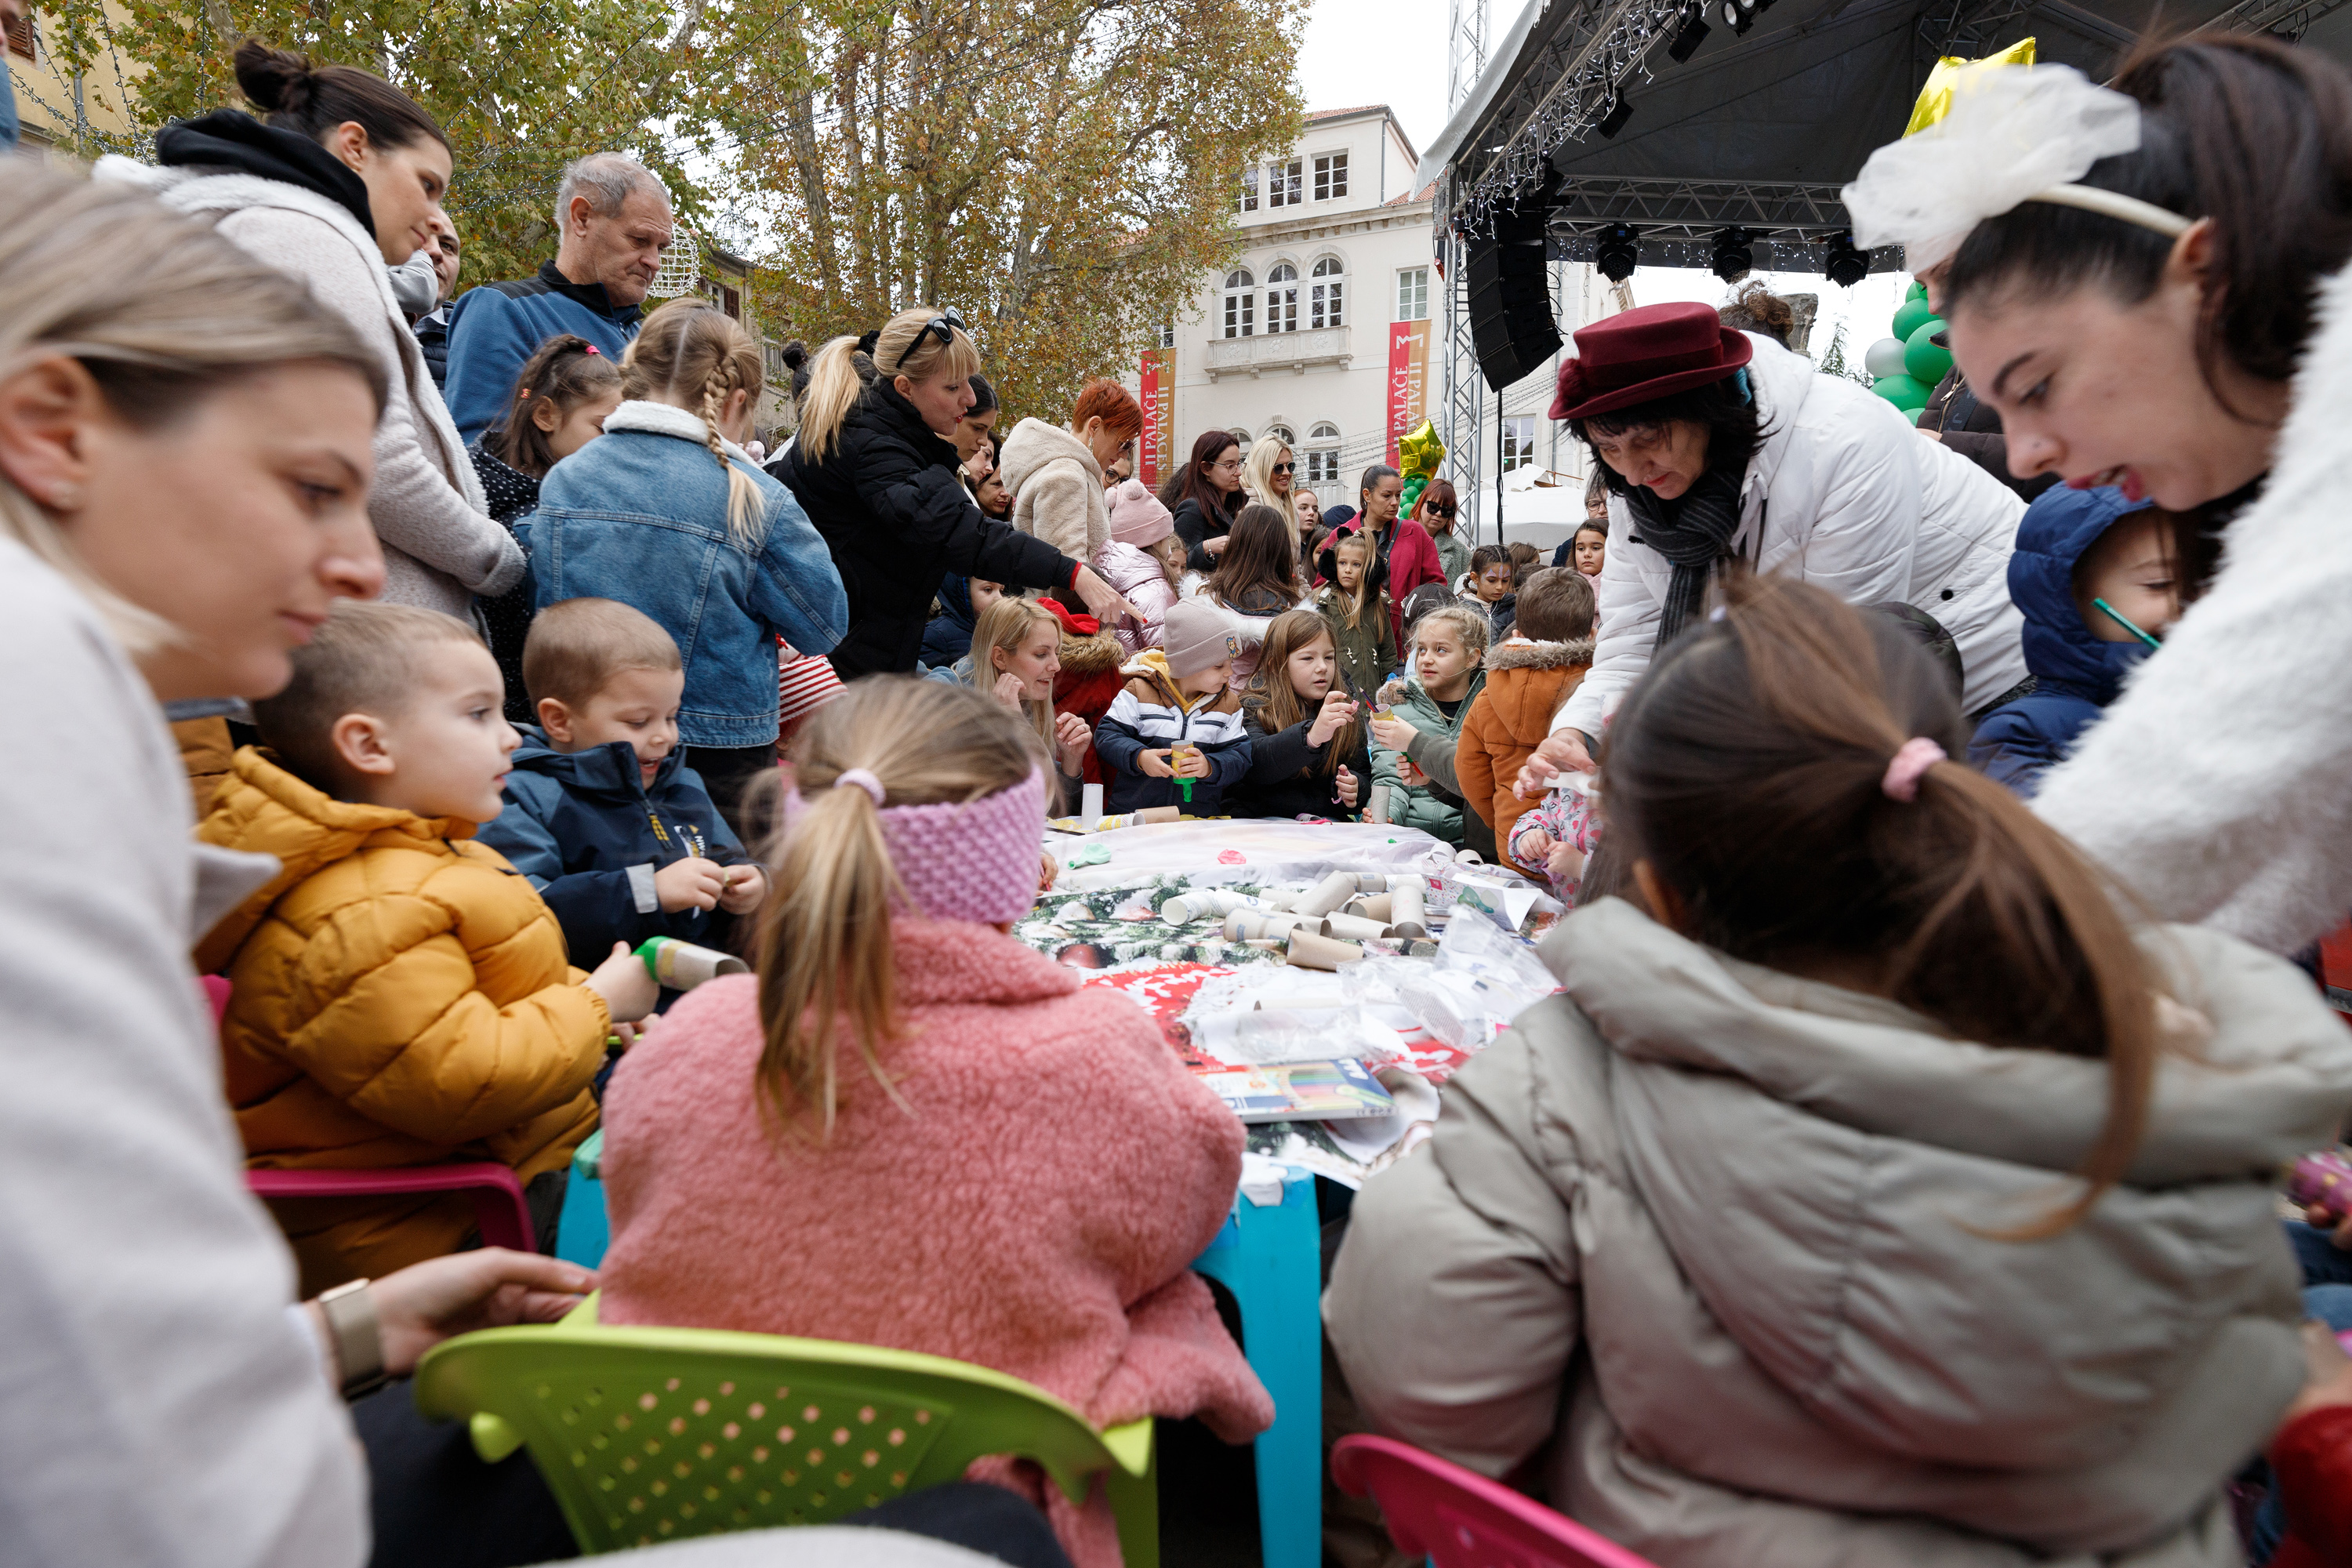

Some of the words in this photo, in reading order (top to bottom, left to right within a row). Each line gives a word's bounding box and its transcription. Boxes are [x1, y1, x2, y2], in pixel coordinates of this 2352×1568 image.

[1158, 387, 1169, 397] II
[1410, 361, 1422, 374] II
[1143, 390, 1157, 450] PALAČE
[1392, 366, 1408, 430] PALAČE
[1407, 379, 1421, 433] PALAC
[1145, 454, 1156, 466] II
[1156, 402, 1169, 470] PALACES
